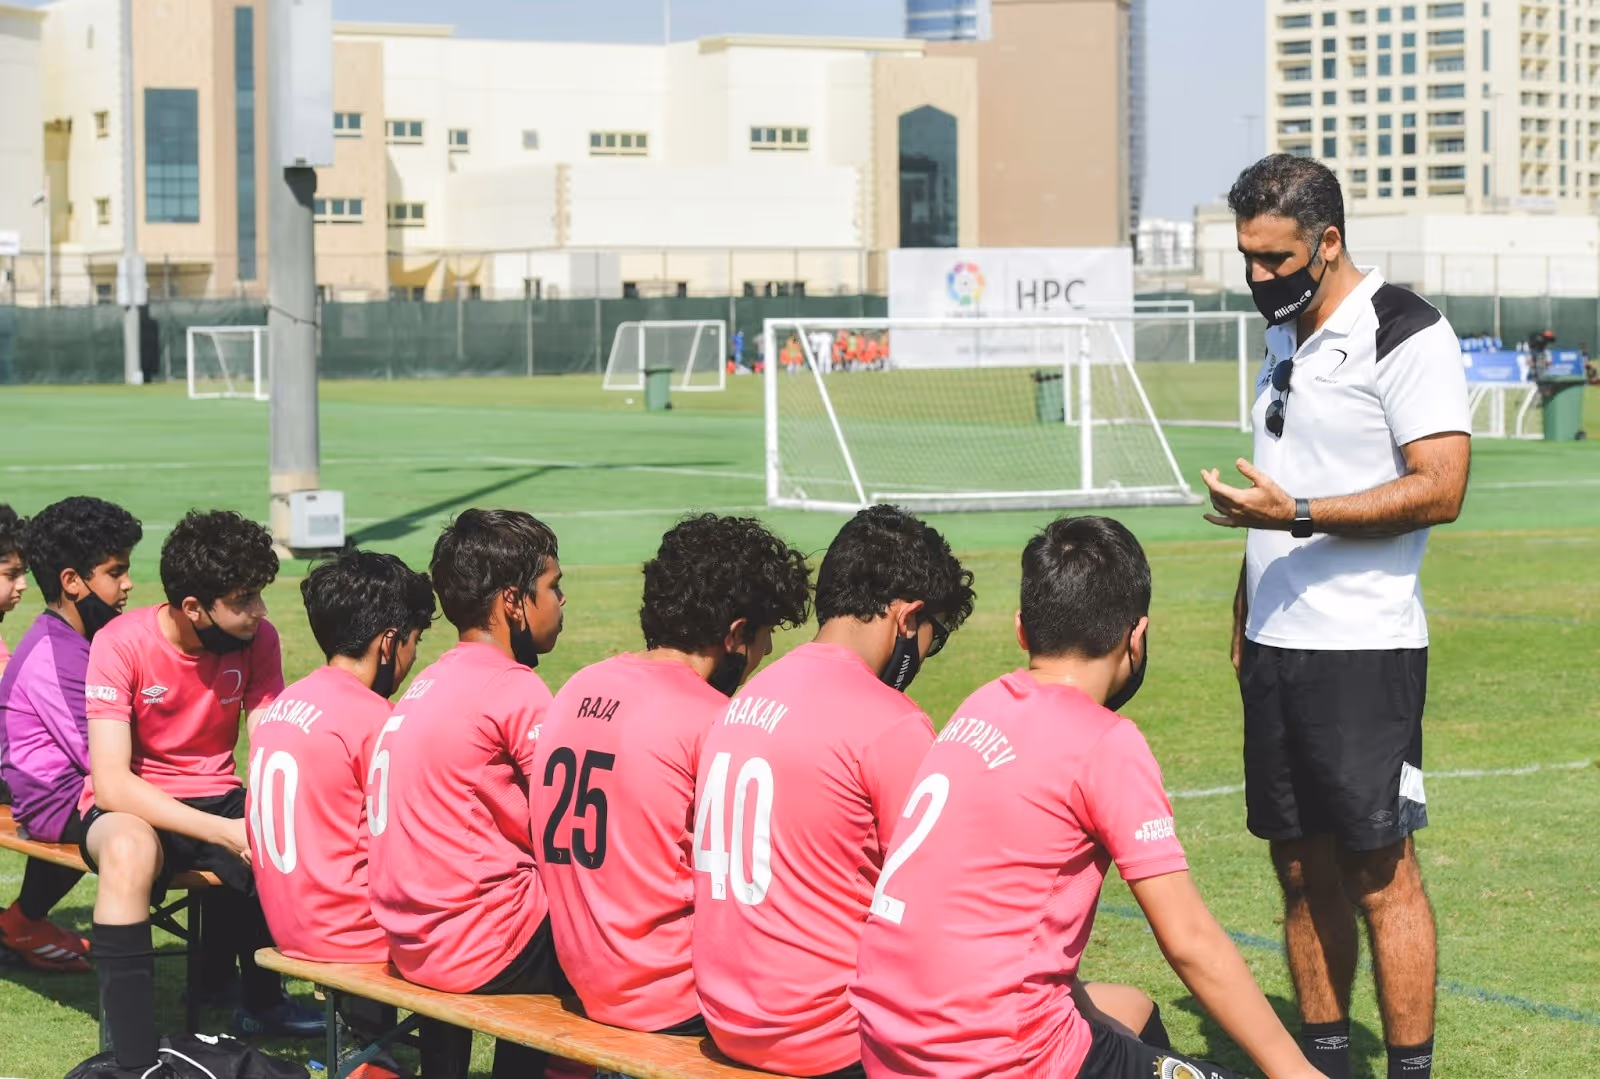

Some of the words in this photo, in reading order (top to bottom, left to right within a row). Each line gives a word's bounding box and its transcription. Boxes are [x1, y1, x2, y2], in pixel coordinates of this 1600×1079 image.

[1017, 279, 1086, 310] HPC
[1274, 289, 1312, 319] Alliance
[577, 697, 620, 722] RAJA
[724, 697, 788, 734] RAKAN
[934, 717, 1017, 769] ORTPAYEV
[250, 747, 299, 874] 10
[366, 714, 405, 837] 5
[543, 747, 616, 870] 25
[693, 752, 774, 905] 40
[869, 773, 950, 925] 2
